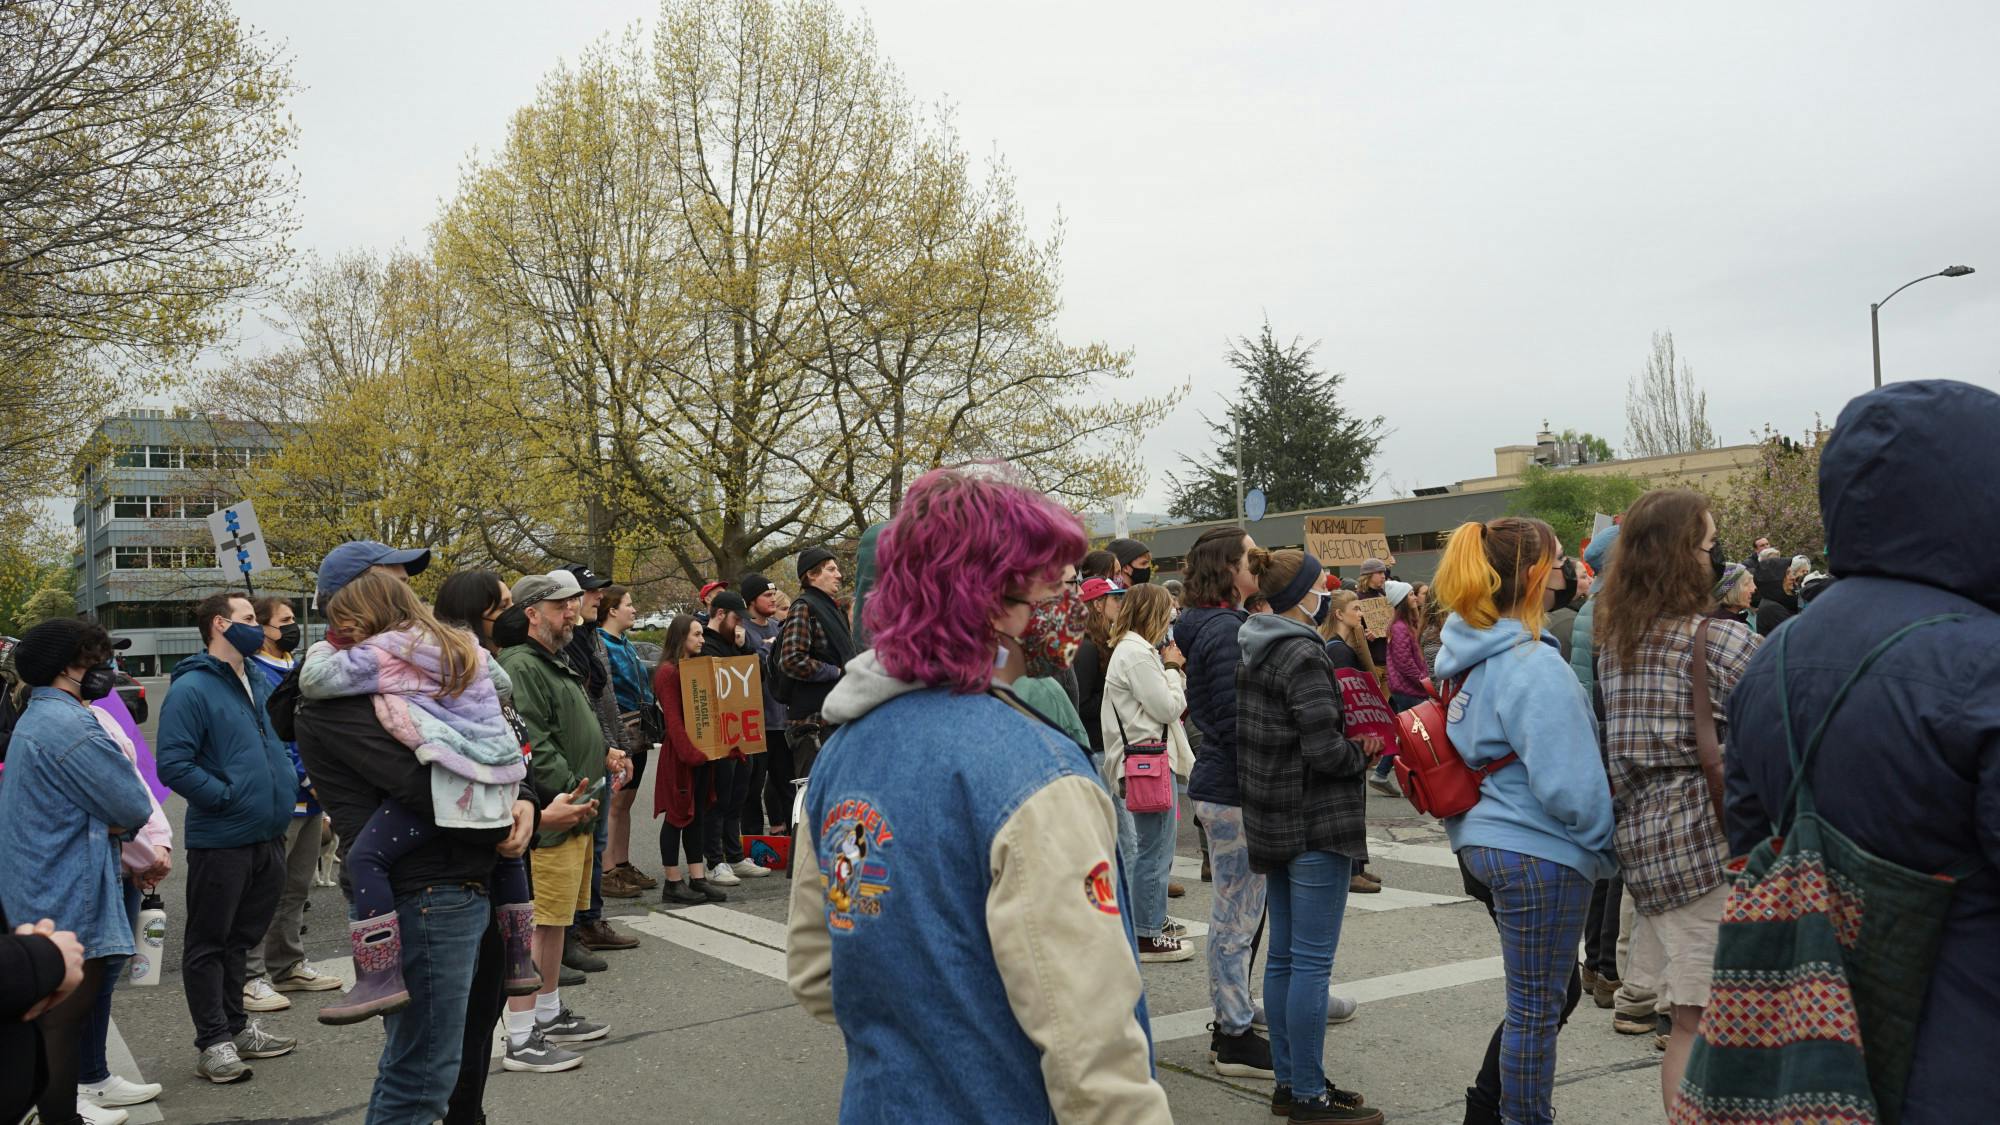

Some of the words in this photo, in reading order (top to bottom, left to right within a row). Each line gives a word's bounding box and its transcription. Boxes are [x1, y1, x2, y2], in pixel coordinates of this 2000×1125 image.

[1311, 519, 1368, 534] NORMALIZE
[1312, 539, 1390, 560] VASECTOMIES
[715, 663, 754, 699] DY
[699, 689, 710, 727] FRAGILE
